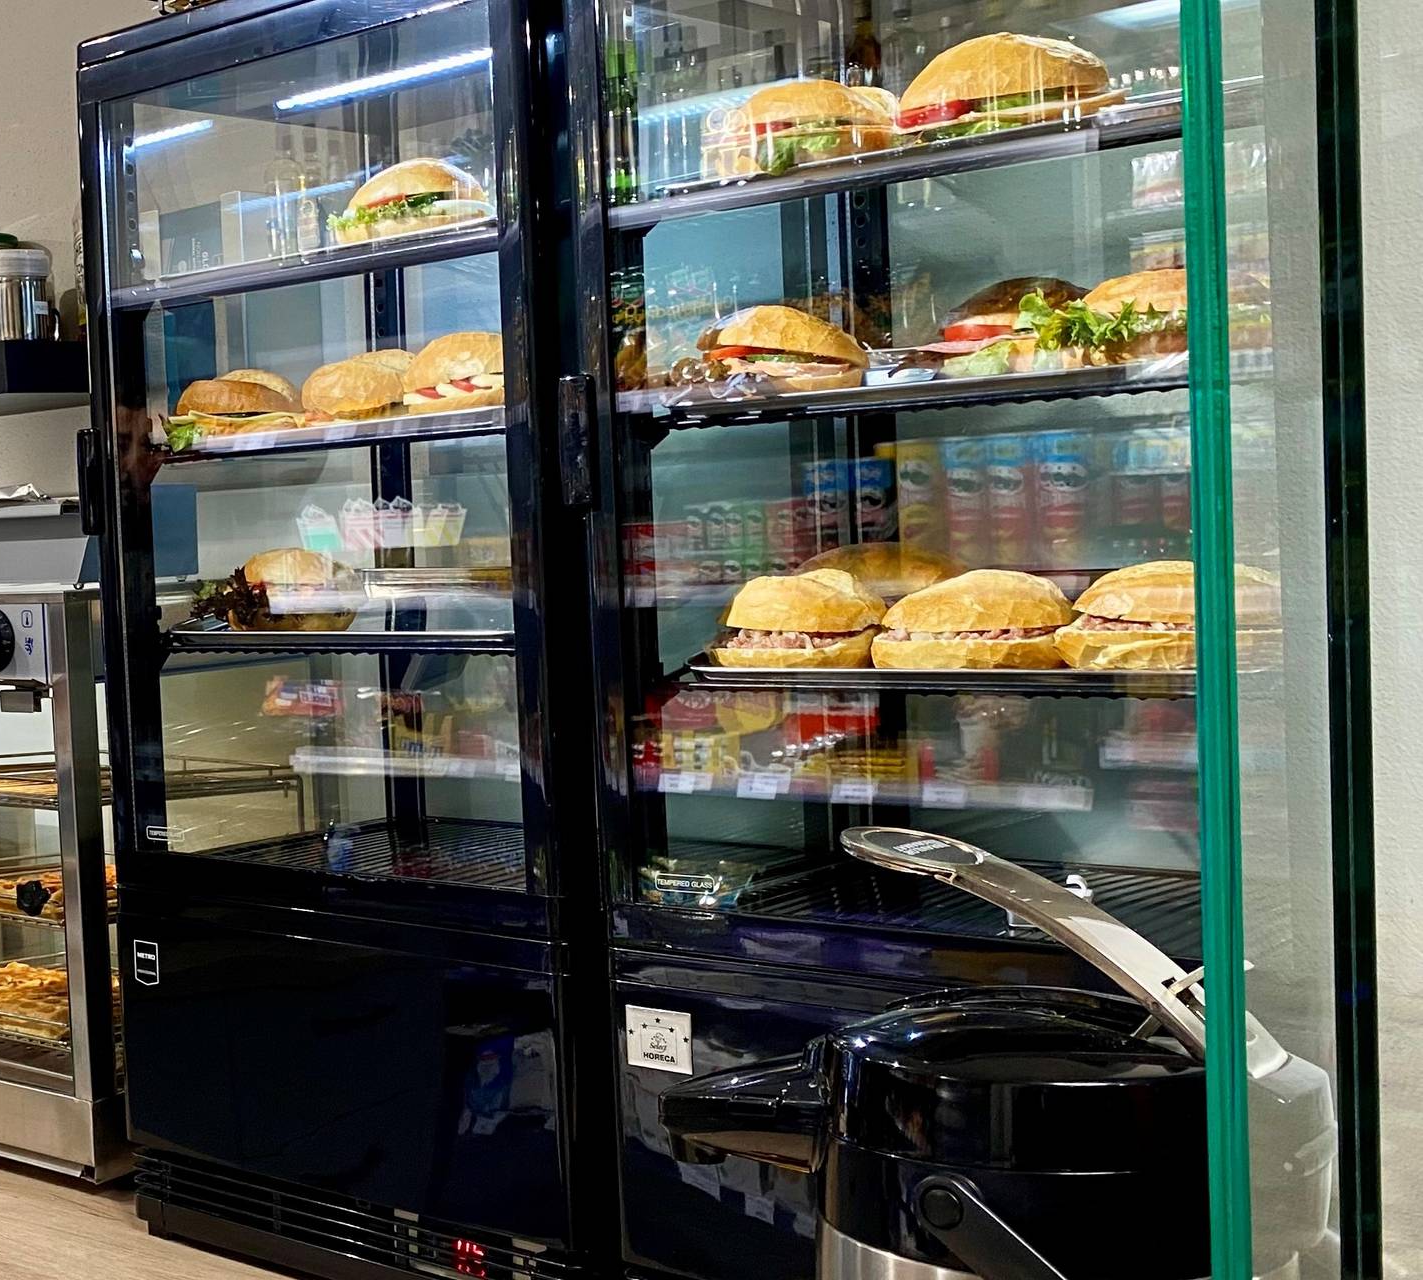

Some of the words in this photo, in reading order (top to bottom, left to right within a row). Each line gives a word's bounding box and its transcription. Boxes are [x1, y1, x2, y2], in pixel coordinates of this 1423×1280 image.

[657, 878, 690, 888] TEMPERED
[691, 880, 713, 889] GLASS
[137, 952, 156, 961] METRO
[643, 1052, 676, 1063] HORECA
